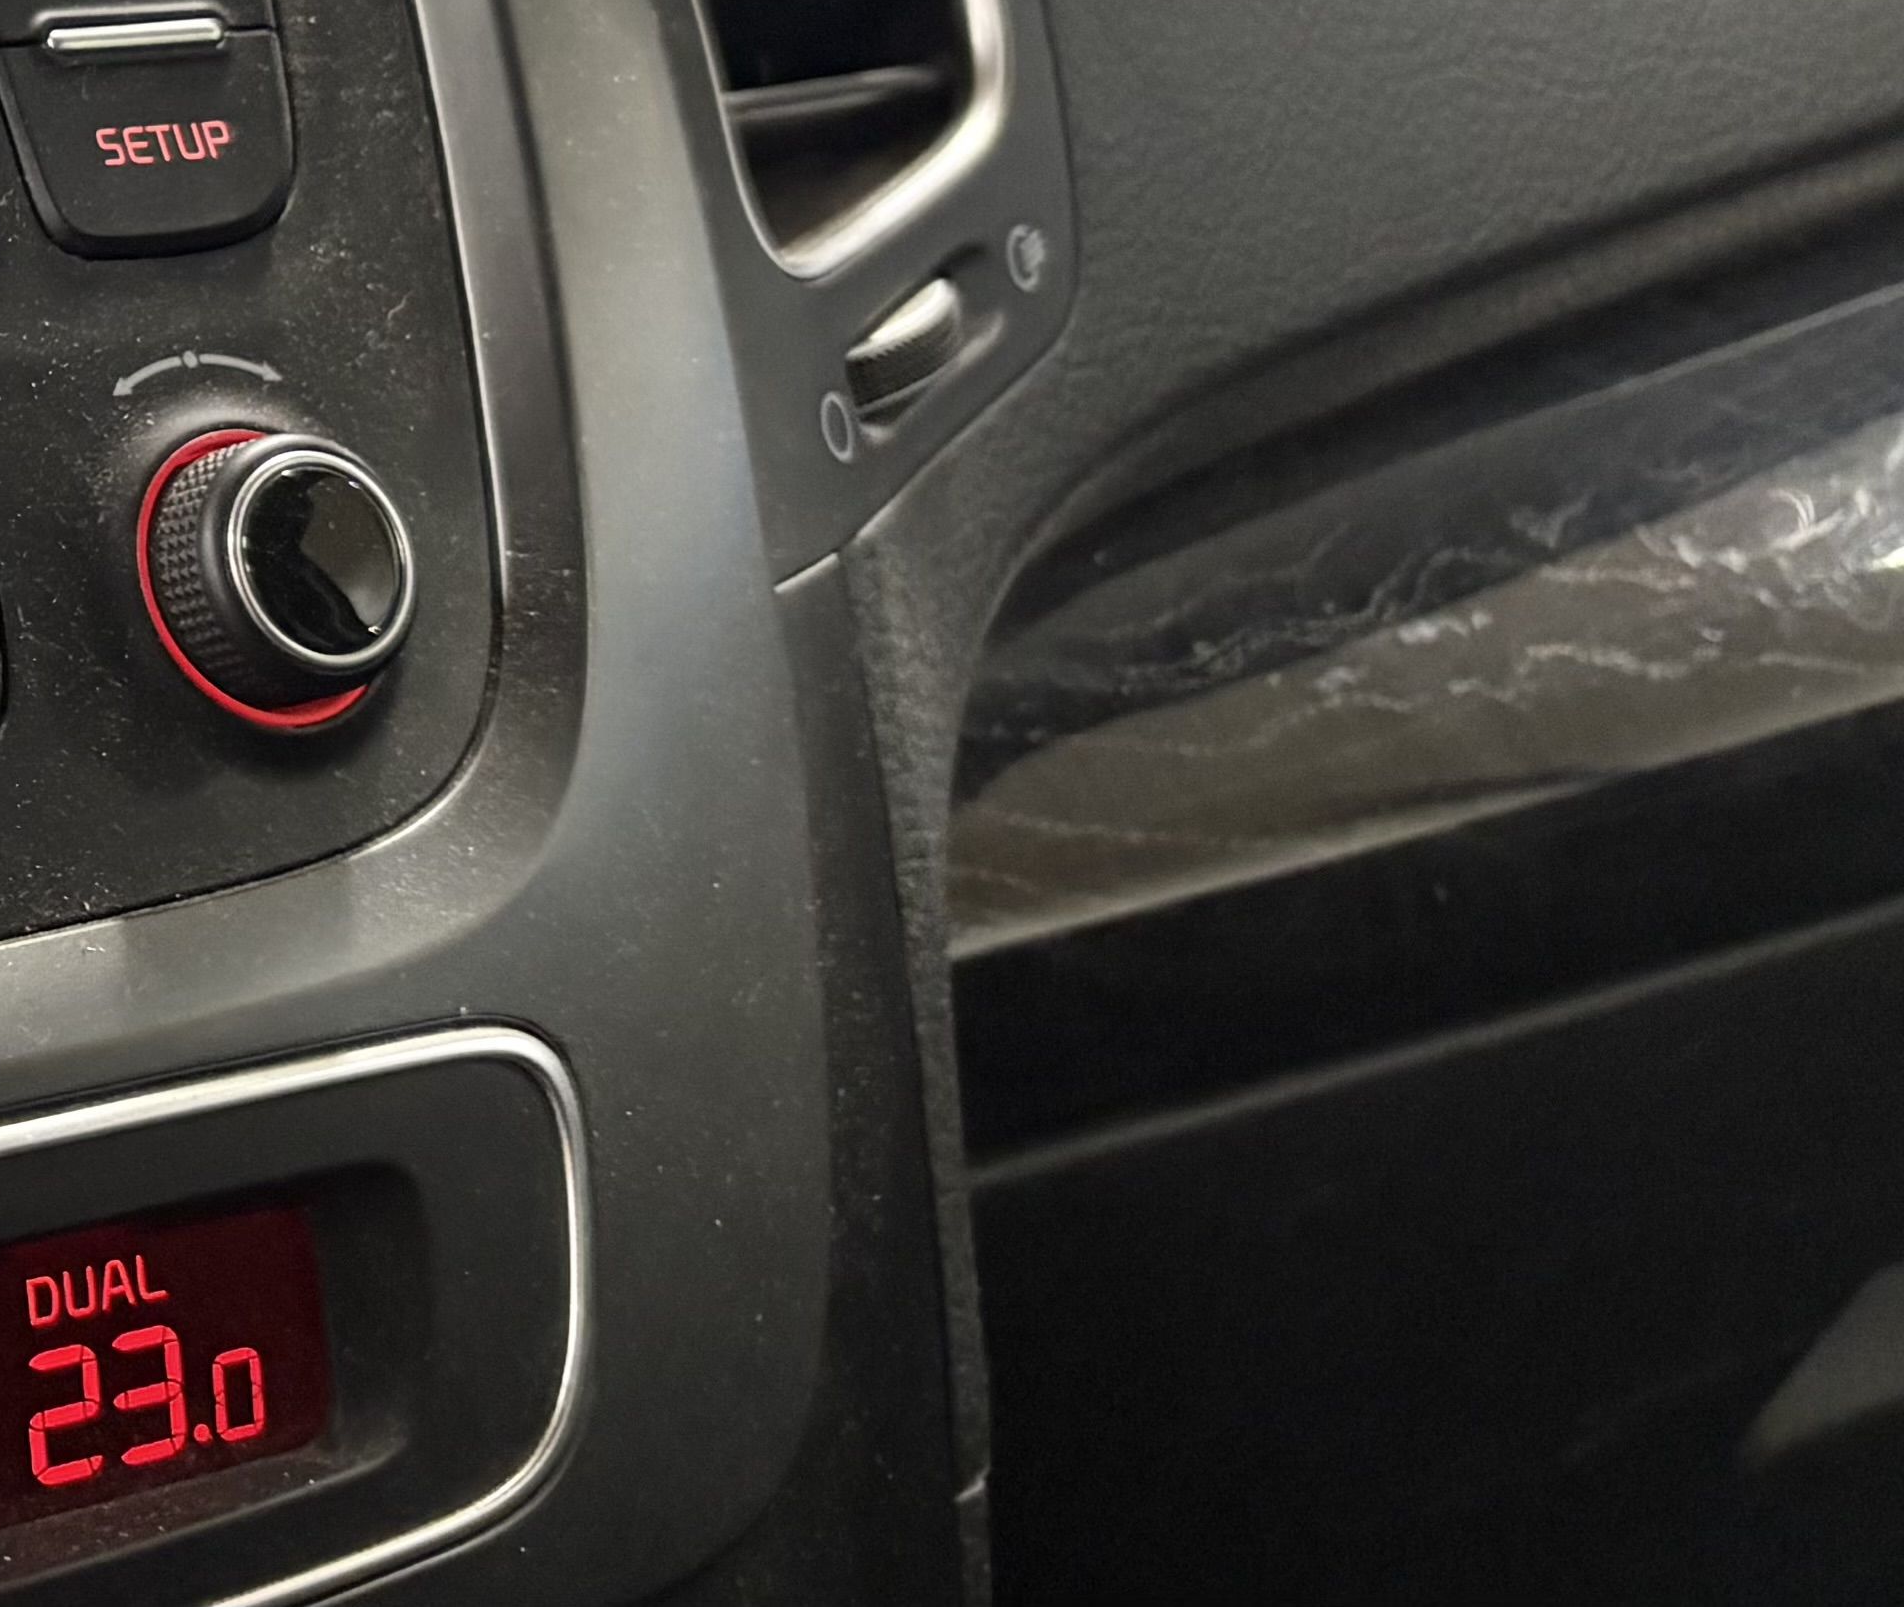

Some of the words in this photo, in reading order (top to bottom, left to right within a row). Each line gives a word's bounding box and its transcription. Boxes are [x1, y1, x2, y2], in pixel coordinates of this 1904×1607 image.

[95, 120, 231, 167] SETUP
[24, 1254, 170, 1329] DUAL
[27, 1323, 267, 1487] 23.0
